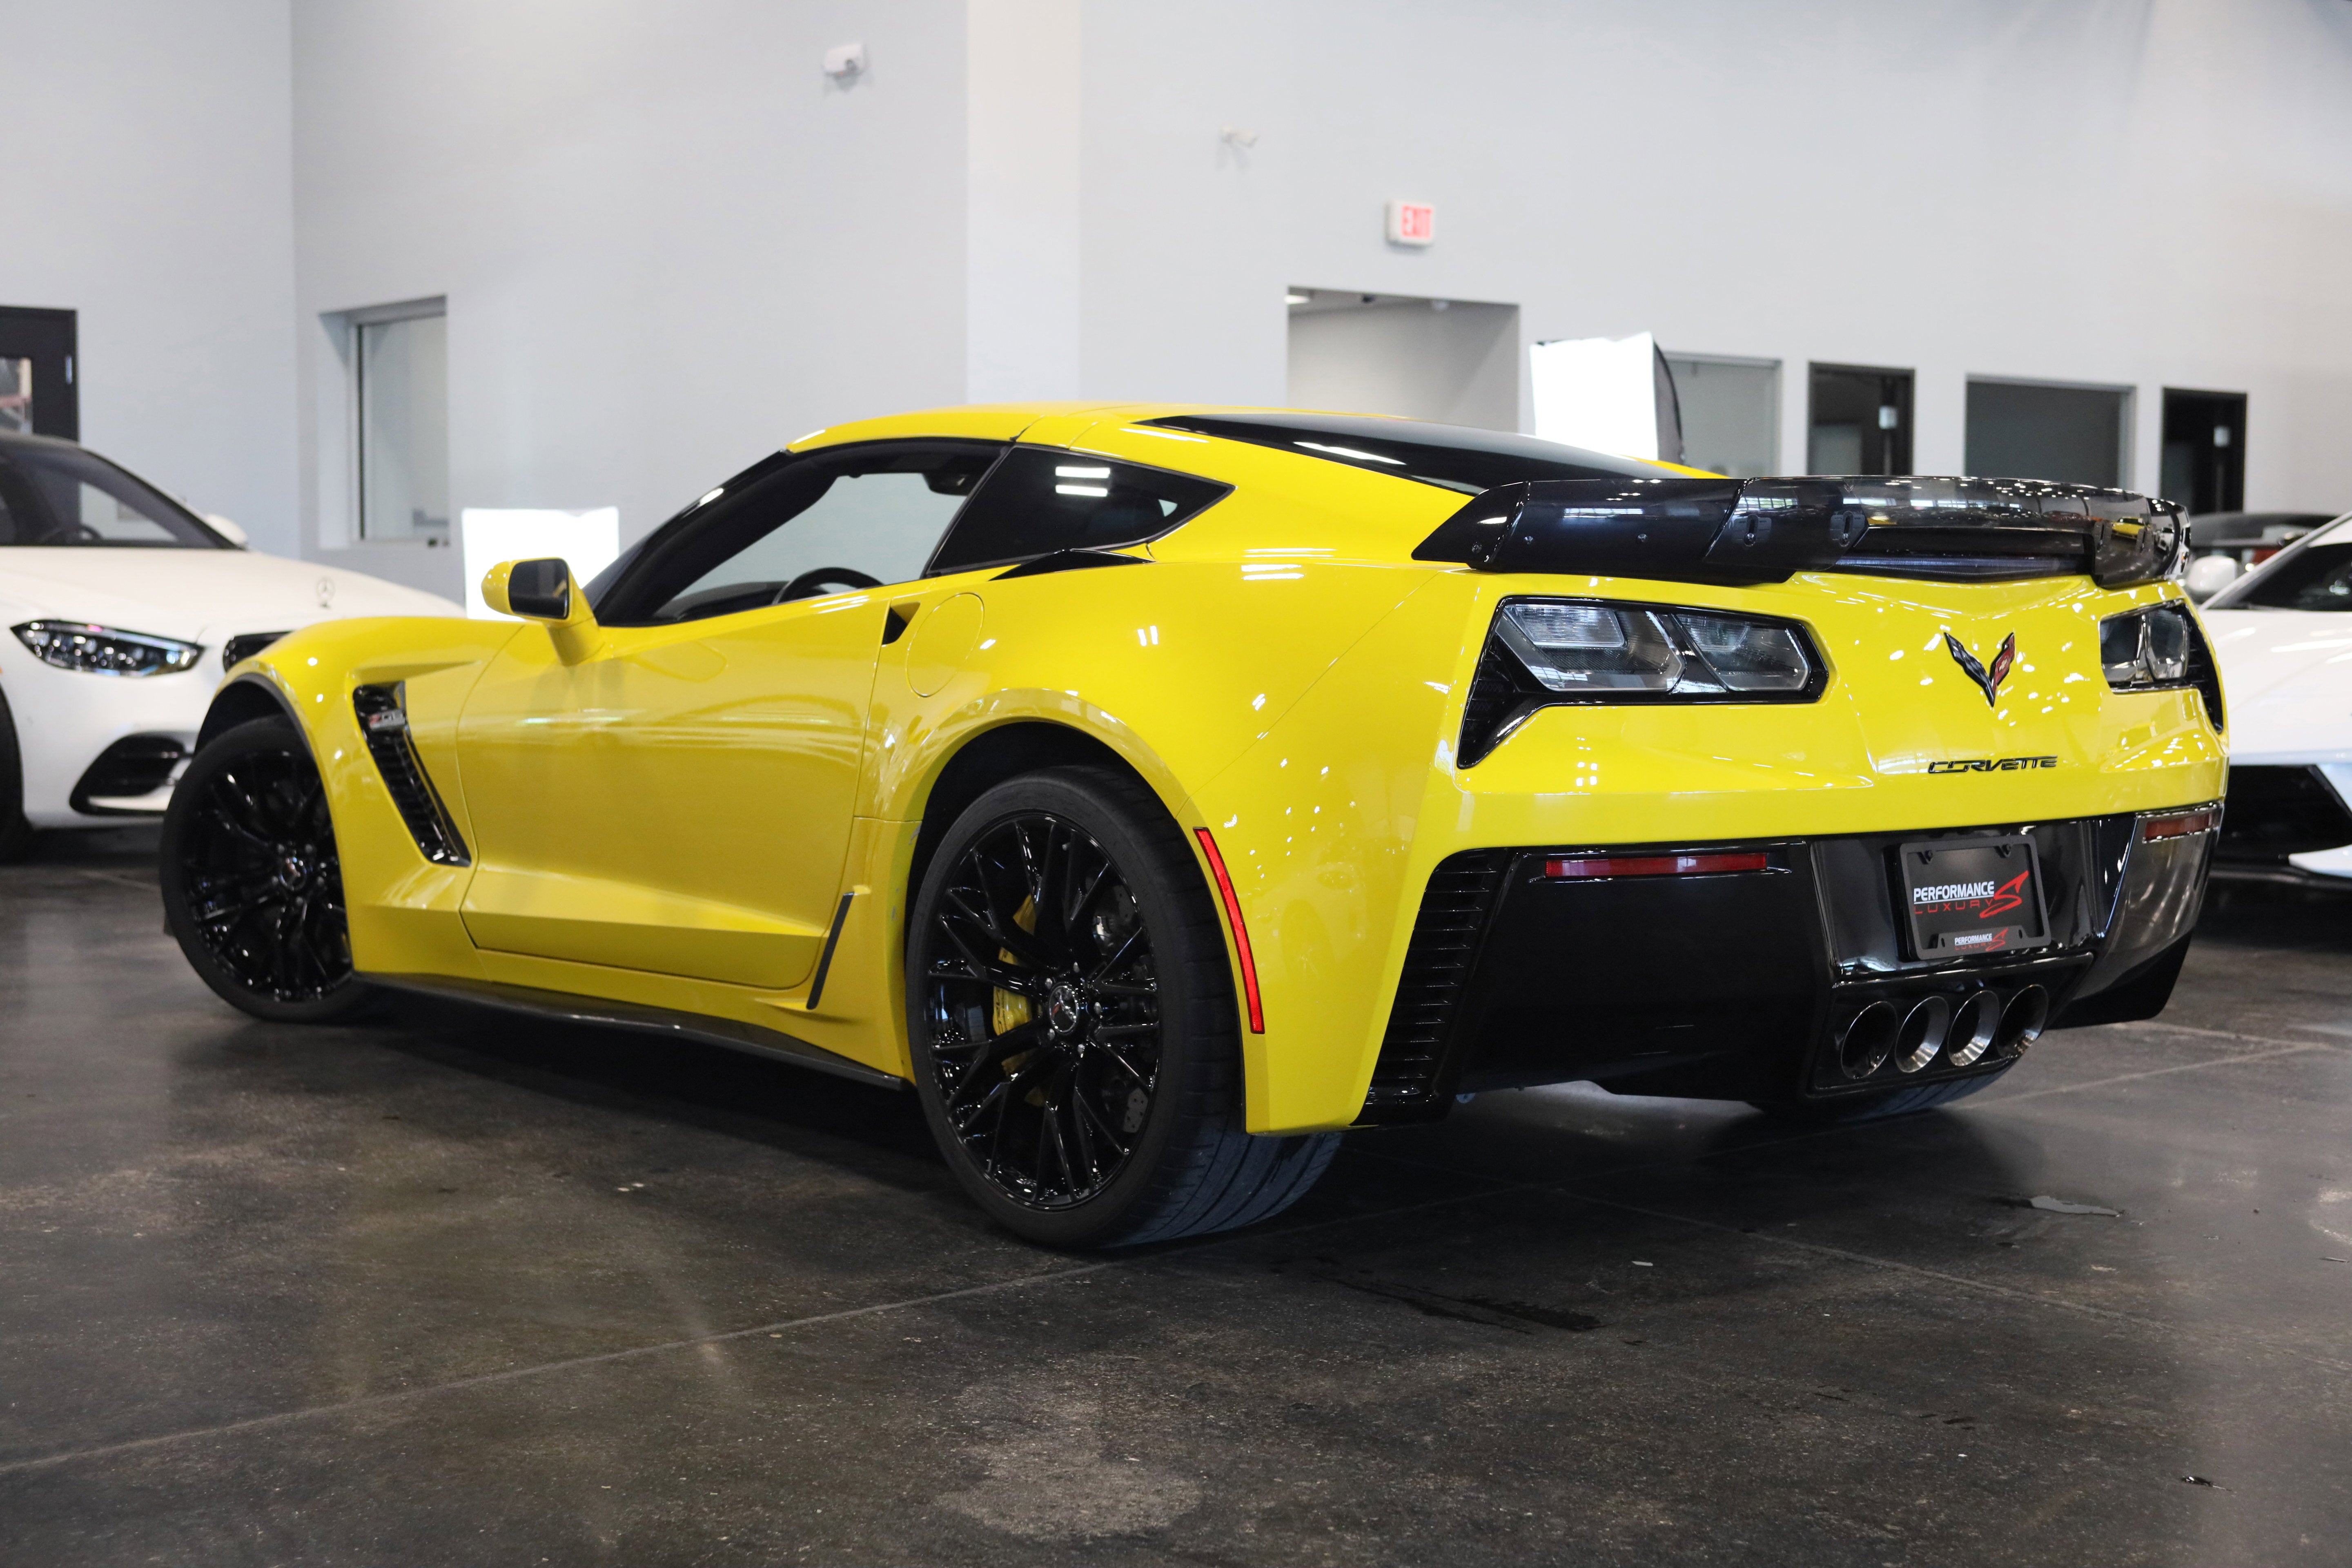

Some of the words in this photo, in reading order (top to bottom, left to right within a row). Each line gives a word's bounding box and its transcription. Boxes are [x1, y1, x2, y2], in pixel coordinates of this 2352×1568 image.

[1928, 755, 2058, 774] CORVETTE
[1913, 881, 1994, 902] PERFORMANCE
[1914, 899, 1993, 914] LUXURY
[1954, 933, 1992, 944] PERFORMANCE
